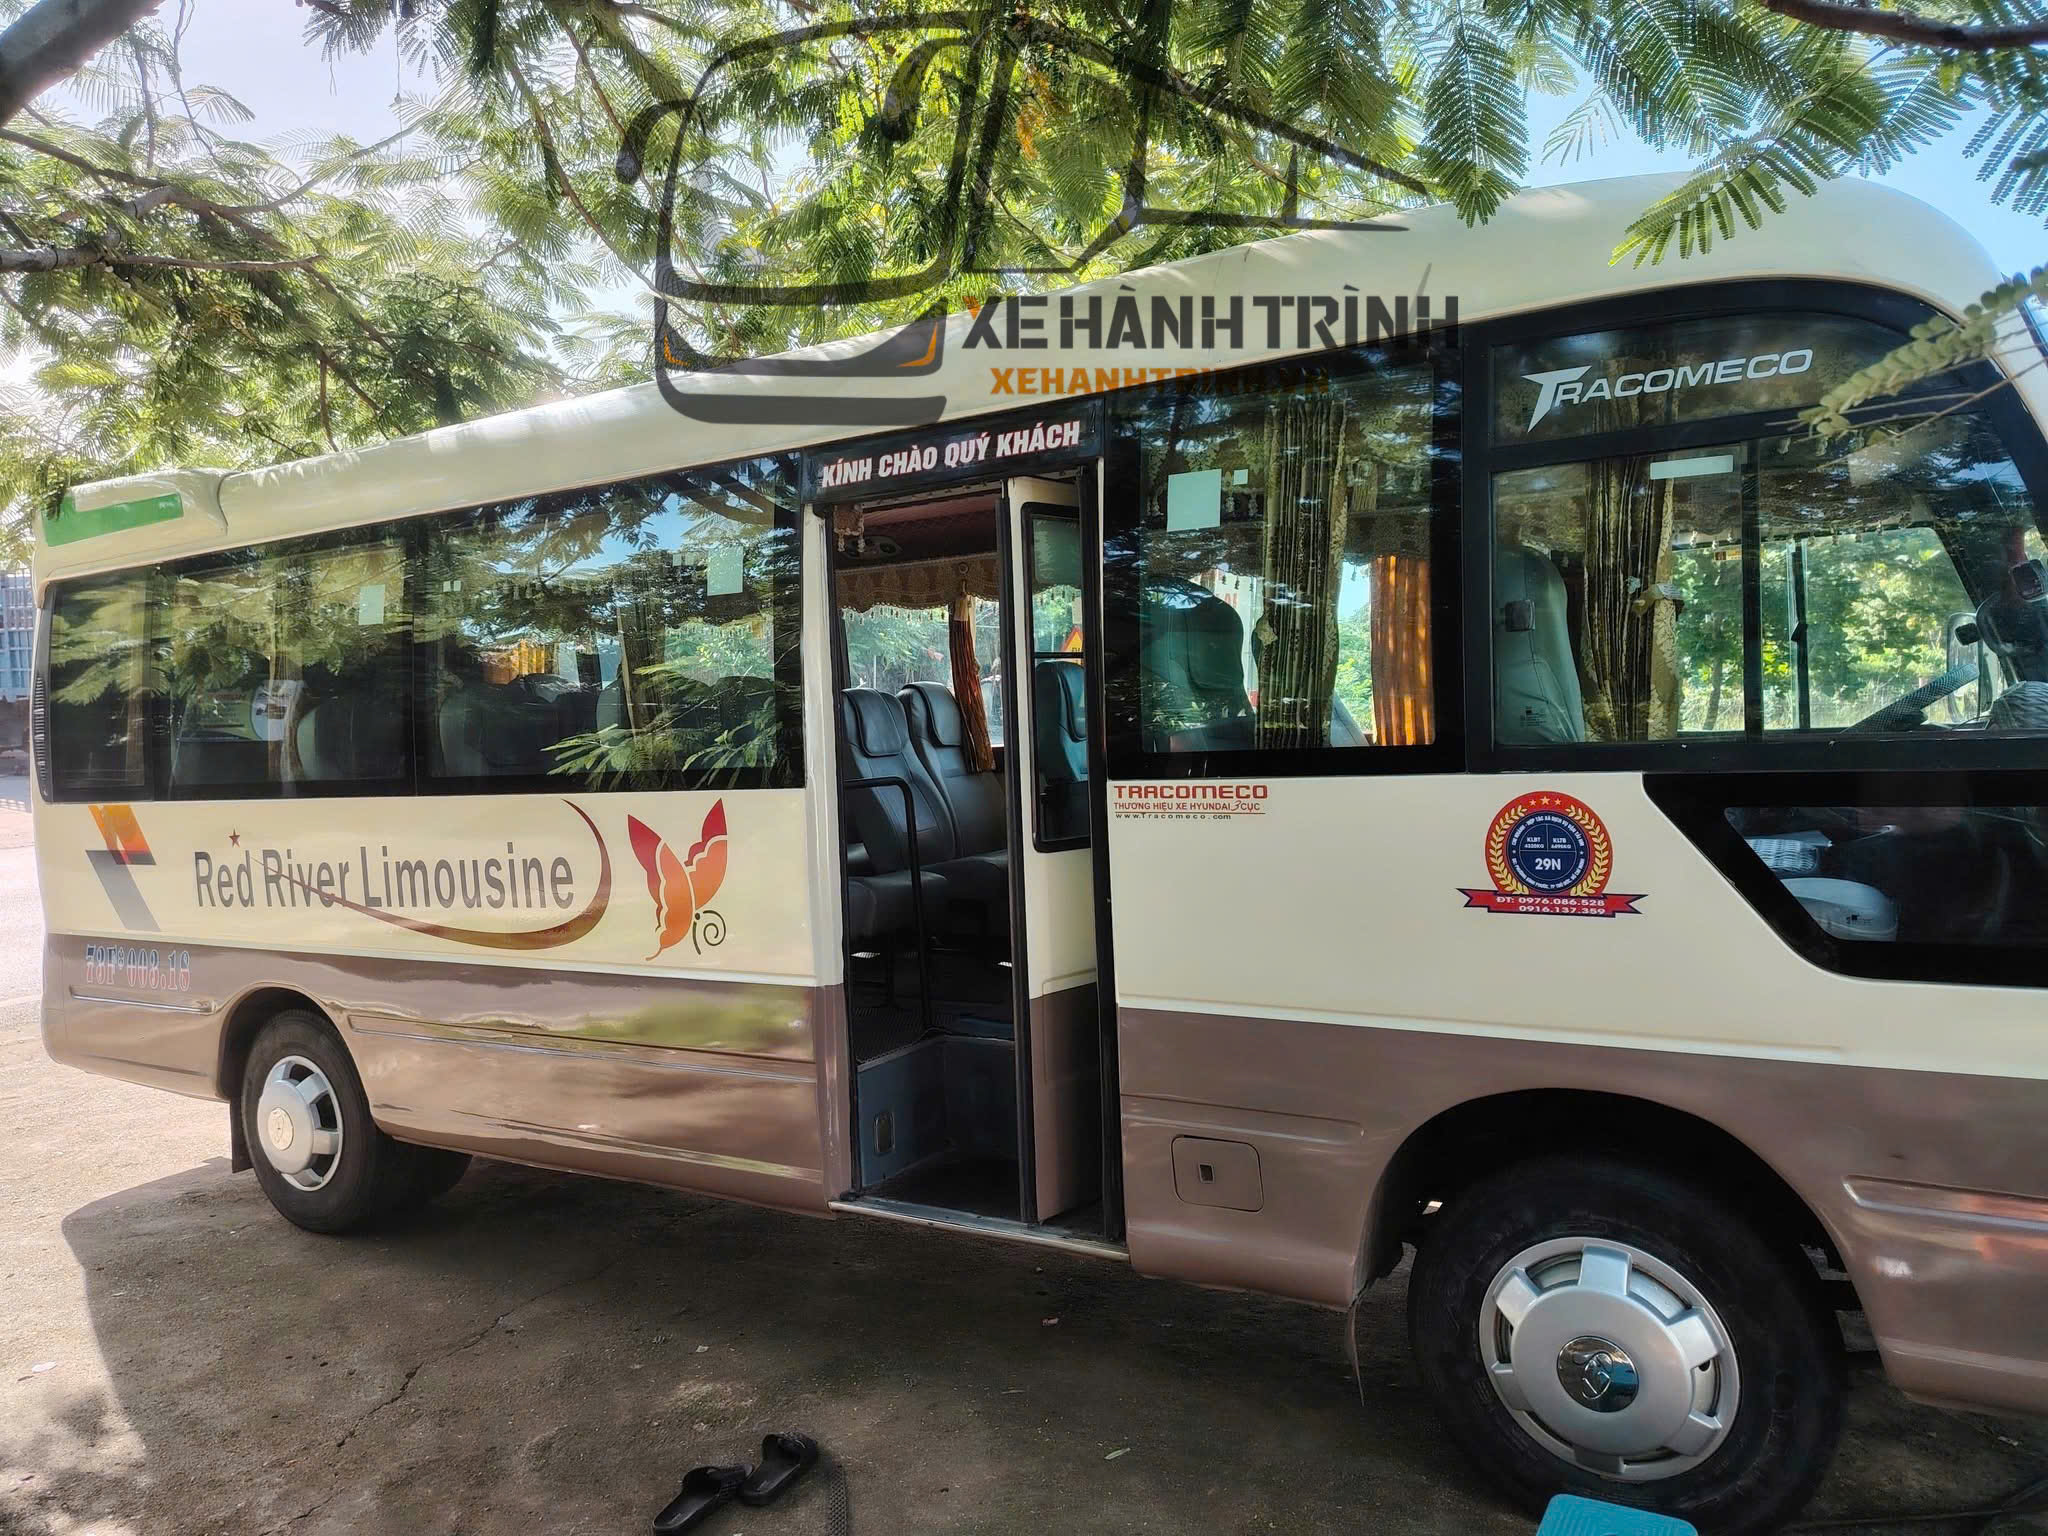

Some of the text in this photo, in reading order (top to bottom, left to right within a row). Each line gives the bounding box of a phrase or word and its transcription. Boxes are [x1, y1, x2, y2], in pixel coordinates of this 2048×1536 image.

[1521, 349, 1813, 433] TRACOMECO
[822, 421, 1081, 488] KÍNH CHÀO QUÝ KHÁCH
[1113, 785, 1268, 799] TRACOMECO
[1114, 801, 1151, 810] THƯƠNG
[1153, 801, 1173, 811] HIỆU
[1176, 802, 1187, 810] XE
[1190, 802, 1230, 811] HYUNDAI
[194, 841, 575, 909] Red River Limousine
[1535, 858, 1561, 870] 29N
